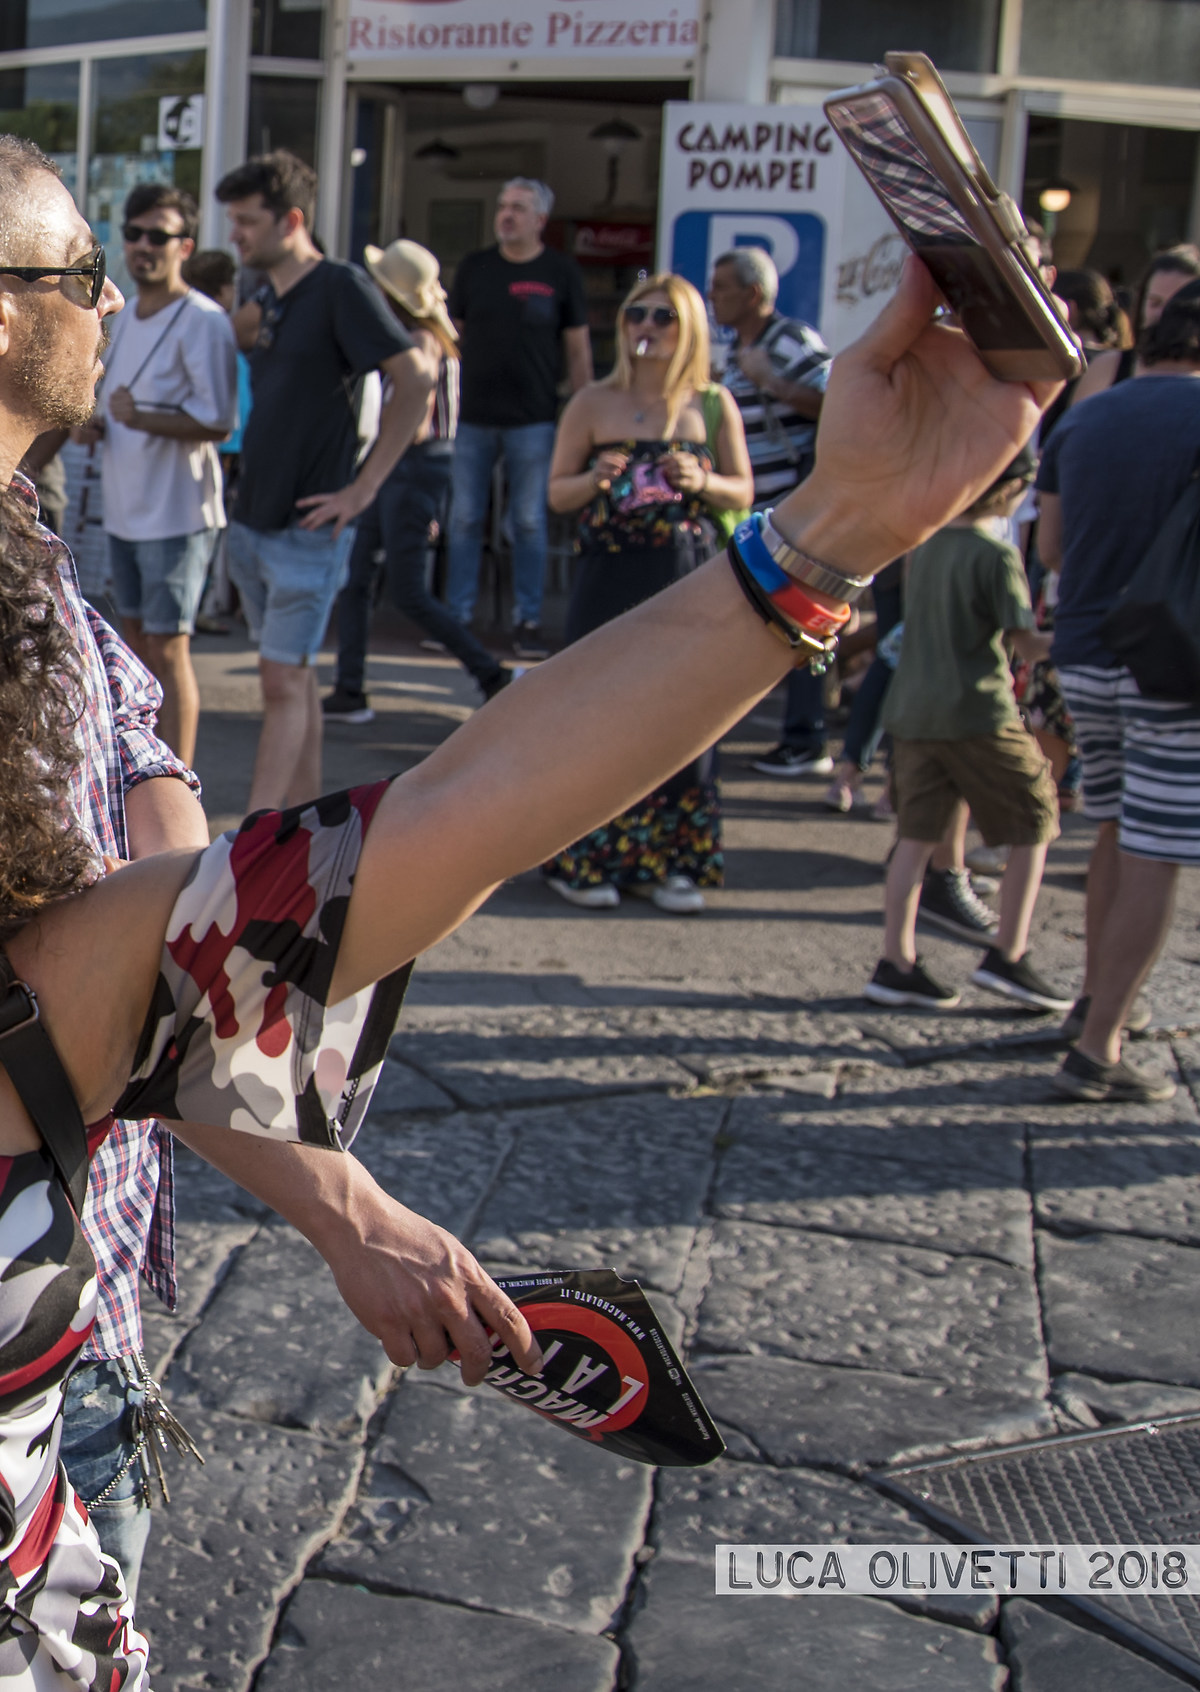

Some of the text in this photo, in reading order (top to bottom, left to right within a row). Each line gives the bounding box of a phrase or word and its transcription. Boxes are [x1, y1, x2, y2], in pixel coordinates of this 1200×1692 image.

[349, 10, 699, 50] Ristorante Pizzeria
[676, 122, 833, 154] CAMPING
[687, 159, 817, 191] POMPEI
[560, 1288, 646, 1341] WWW.MACHOLATO.IT
